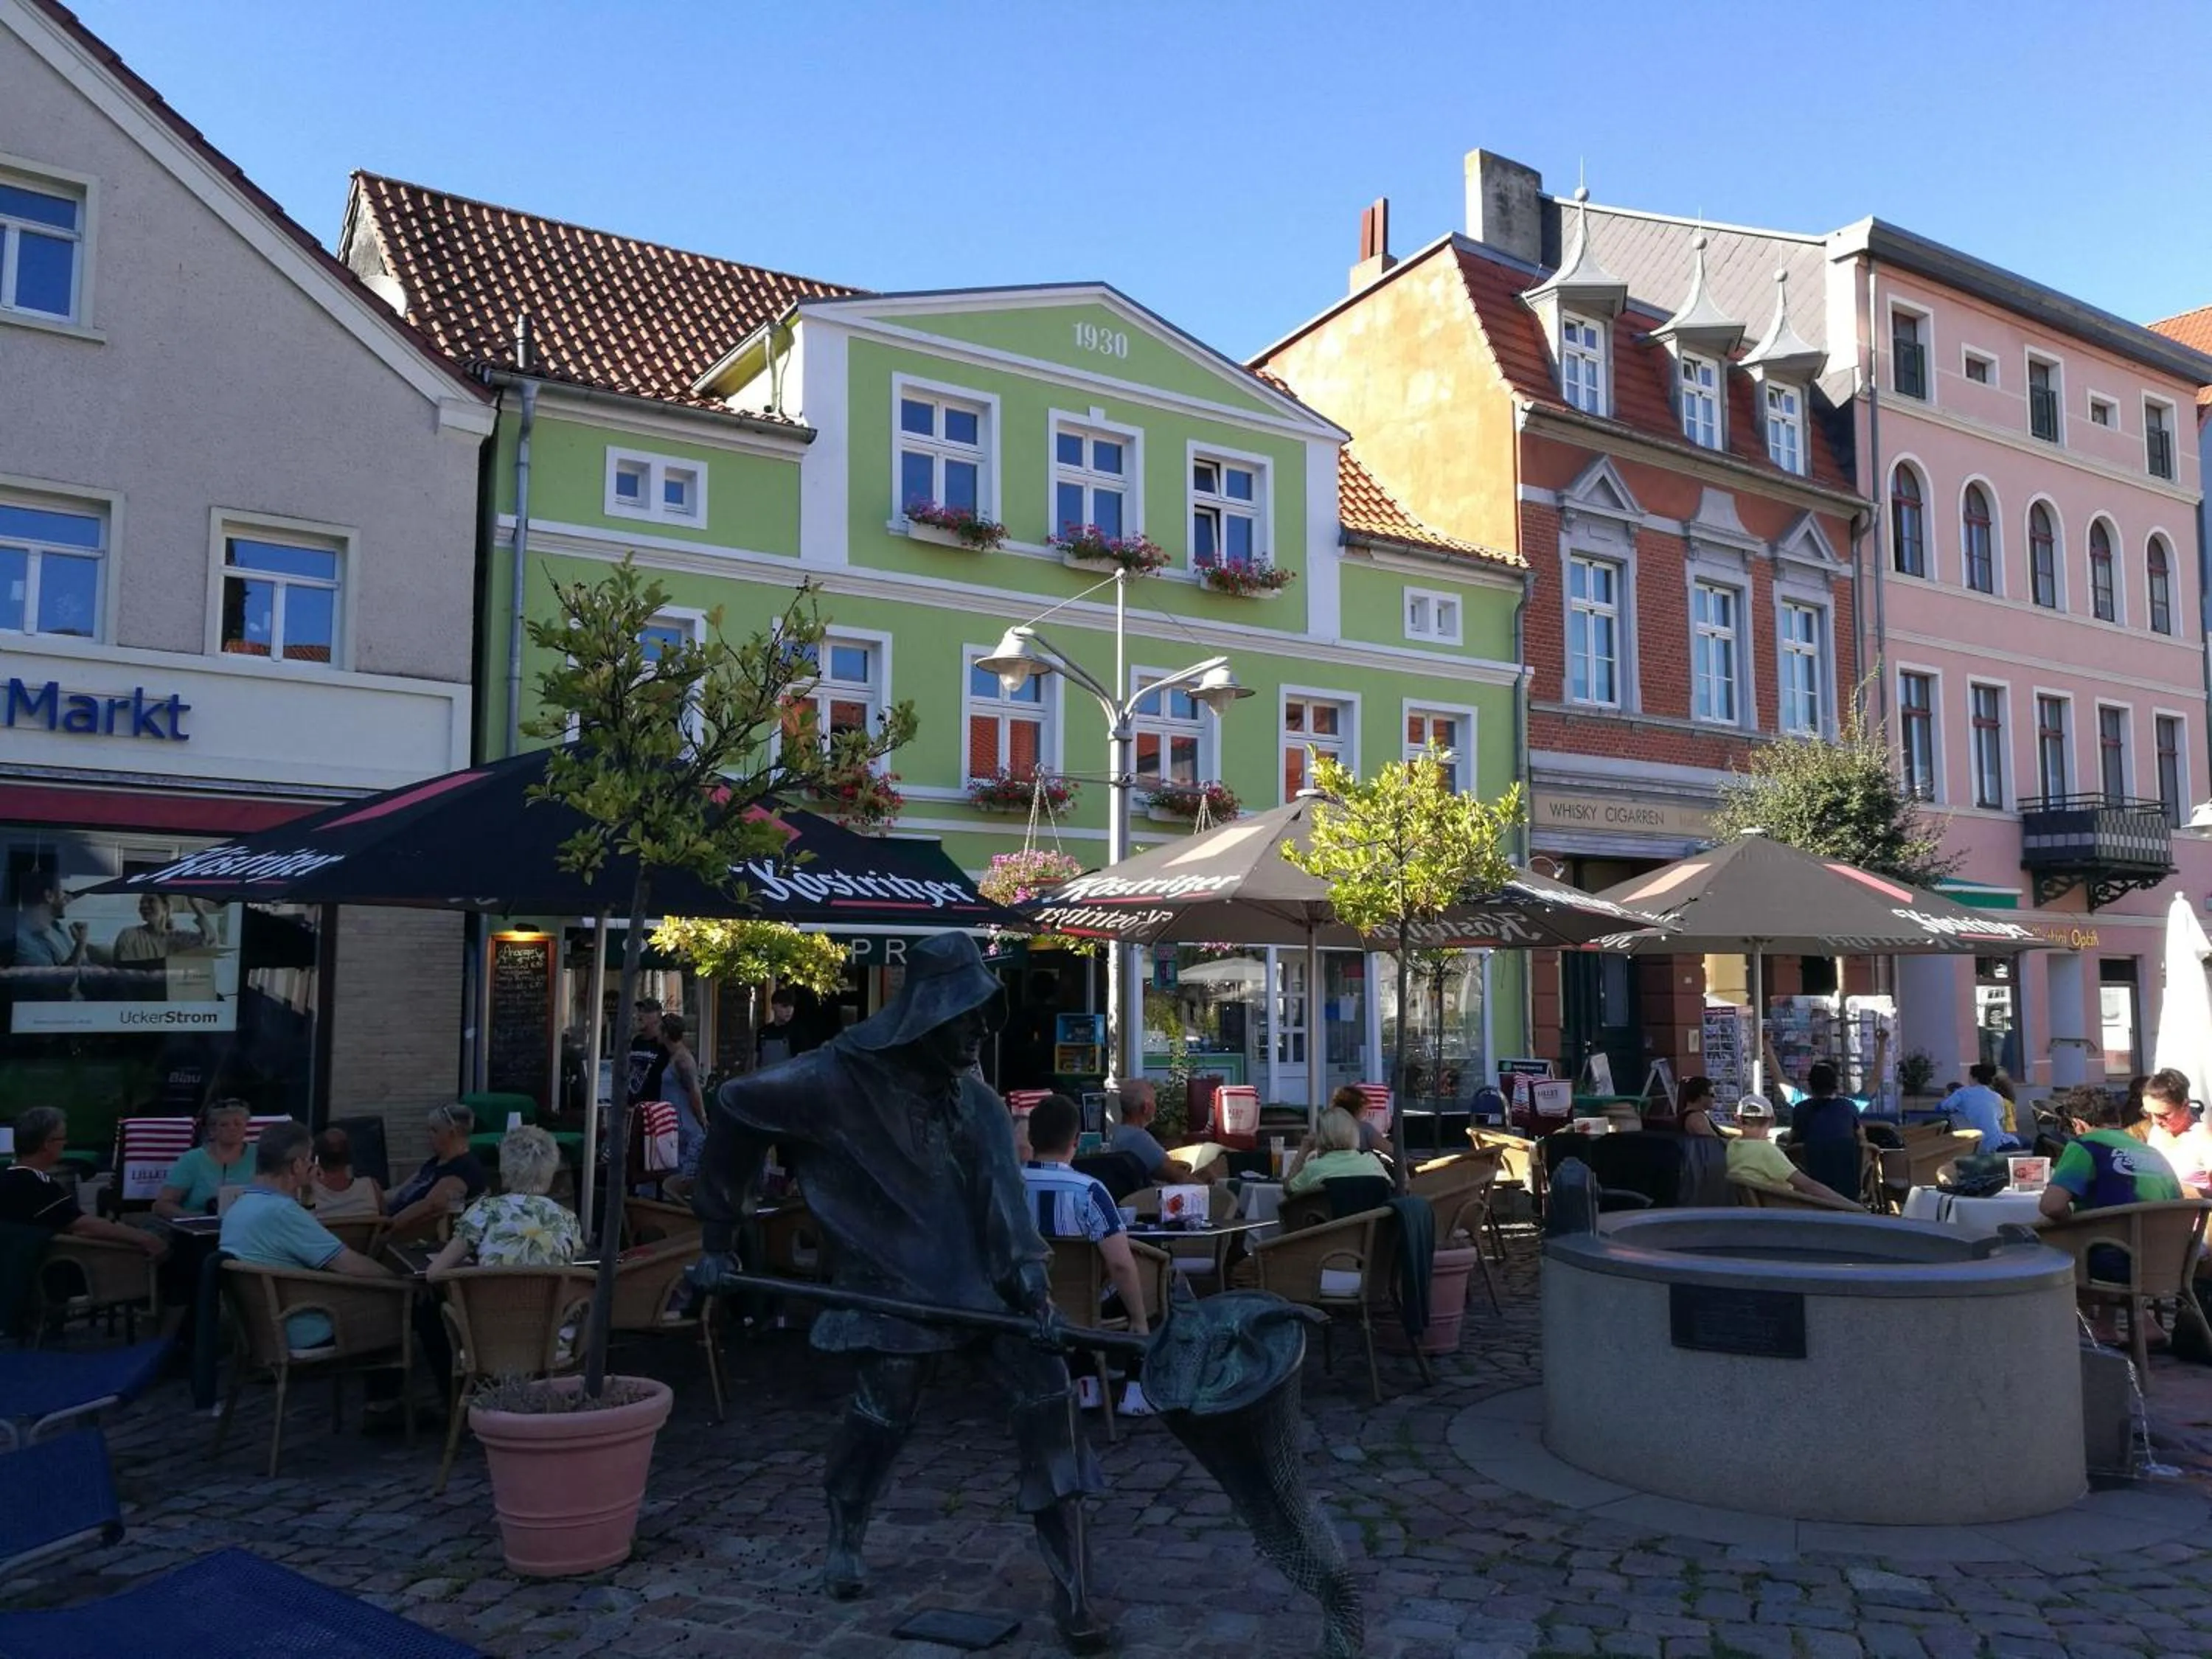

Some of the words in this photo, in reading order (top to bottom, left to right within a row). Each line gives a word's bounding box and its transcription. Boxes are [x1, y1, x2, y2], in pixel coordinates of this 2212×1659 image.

[1073, 321, 1128, 359] 1930
[7, 678, 191, 740] Markt
[1550, 802, 1599, 821] WHISKY
[1605, 807, 1665, 826] CIGARREN
[728, 858, 975, 908] Köstritzer
[1041, 874, 1242, 904] Köstritzer
[120, 1010, 218, 1024] UckerStrom
